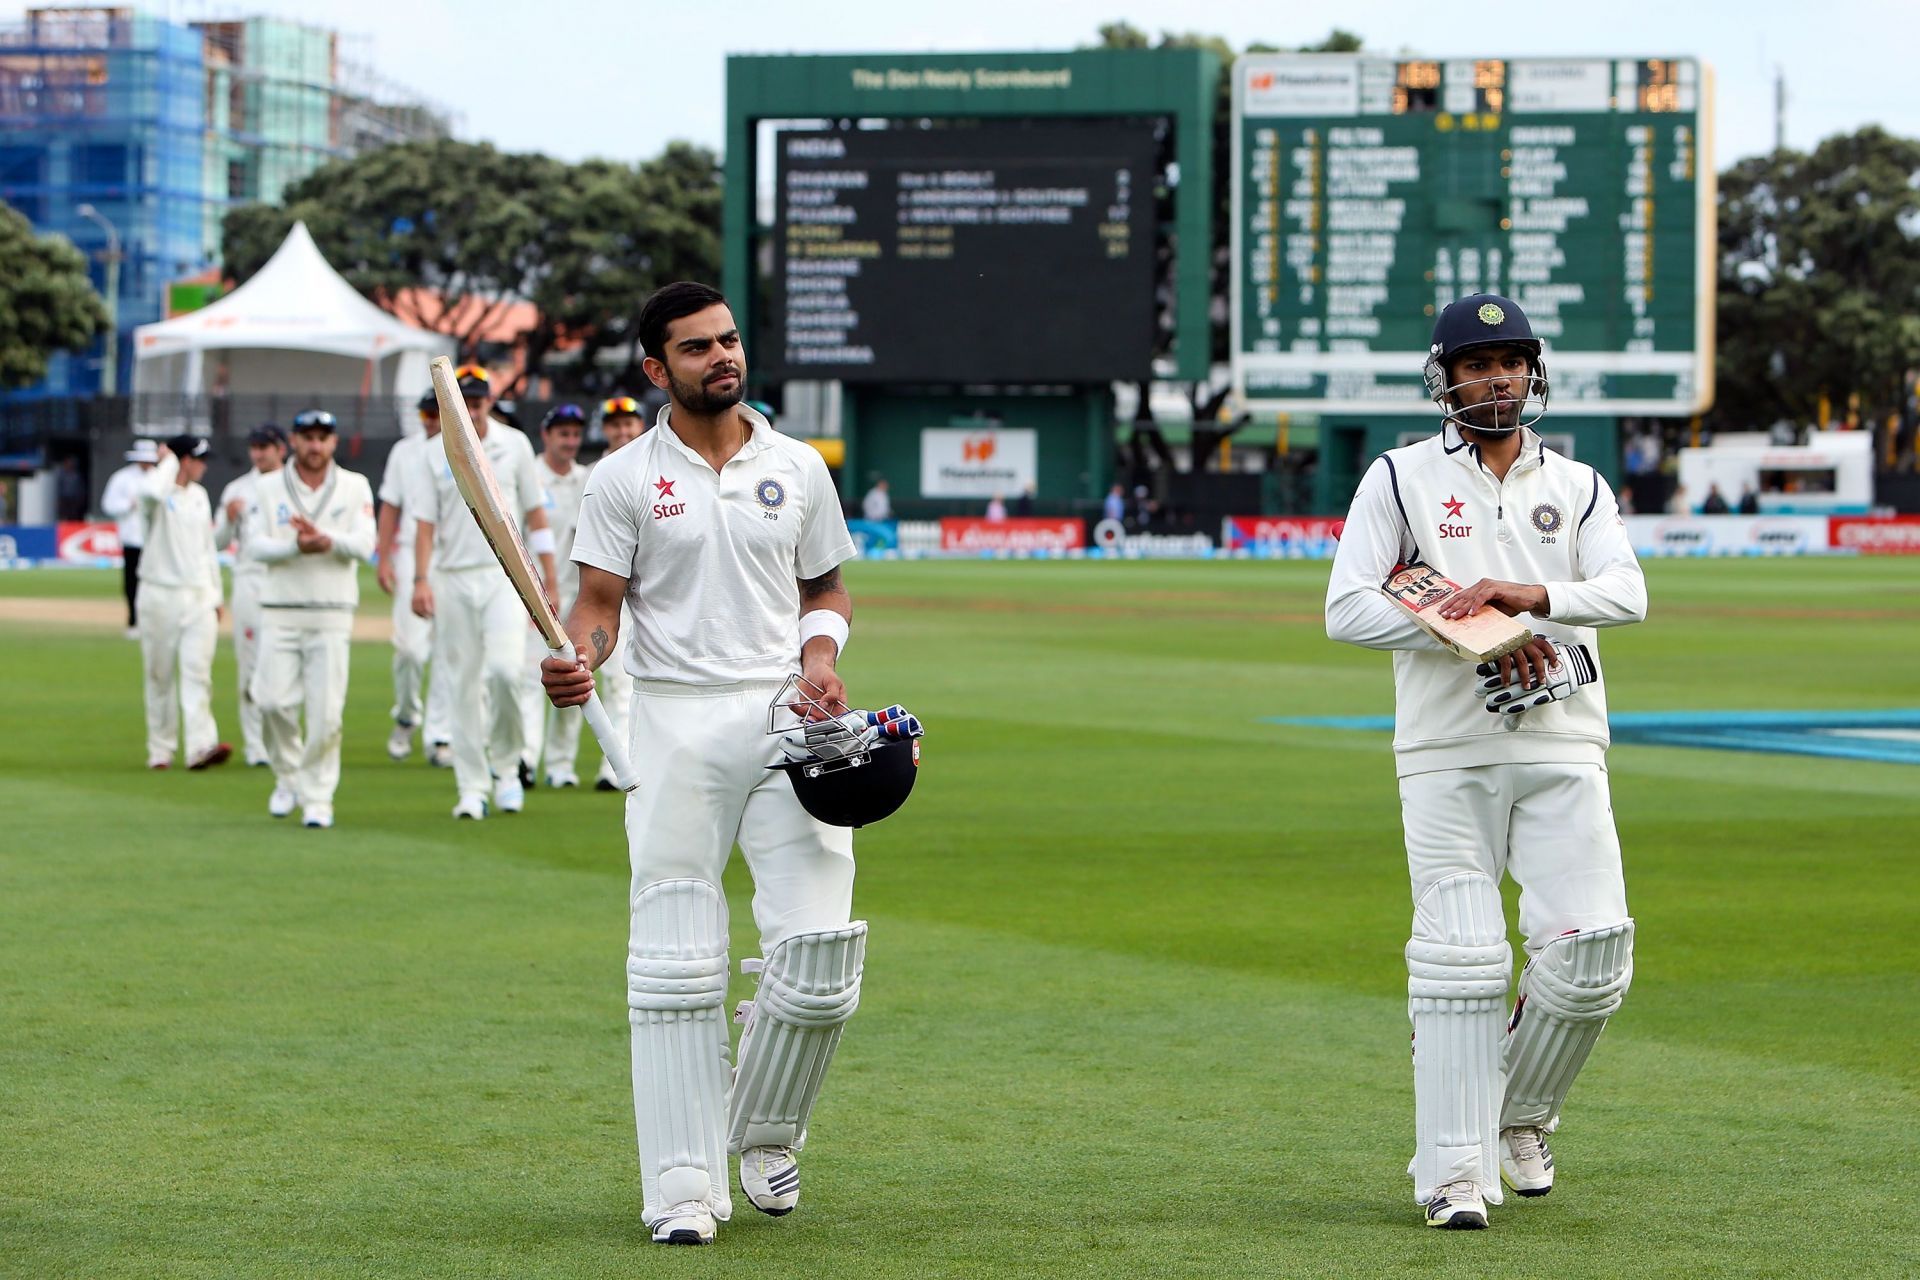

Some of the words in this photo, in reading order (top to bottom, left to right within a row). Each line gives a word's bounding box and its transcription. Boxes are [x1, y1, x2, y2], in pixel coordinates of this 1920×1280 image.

[852, 69, 883, 89] The
[974, 68, 1071, 89] Scoreboard
[653, 502, 686, 520] Star
[763, 511, 778, 521] 269
[1438, 523, 1473, 539] Star
[1540, 536, 1556, 545] 280
